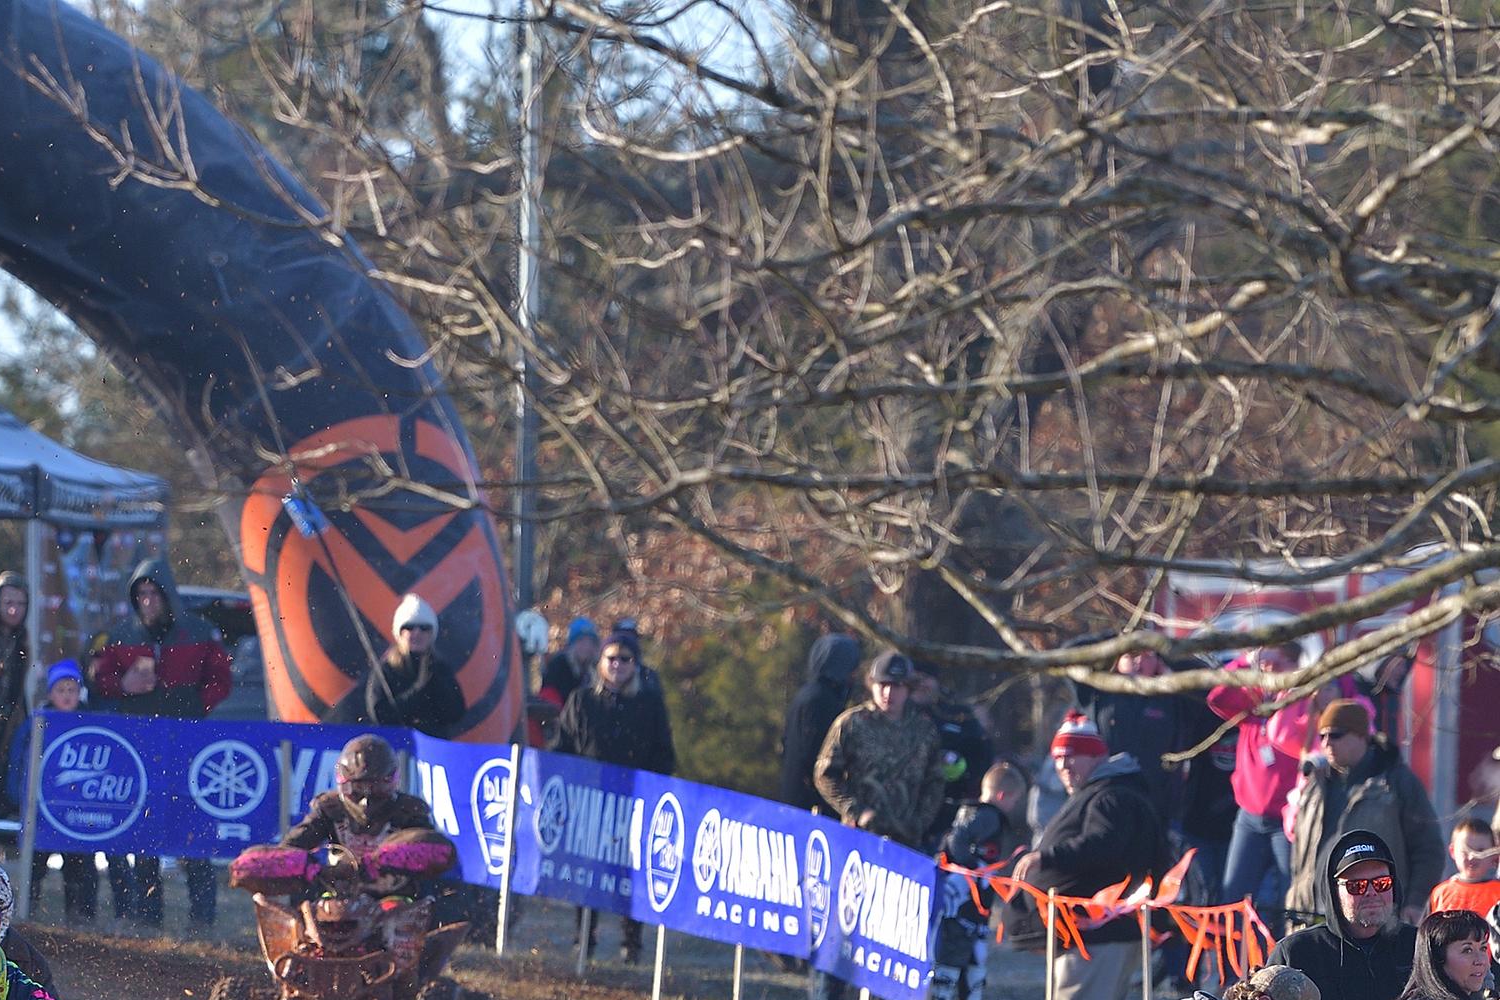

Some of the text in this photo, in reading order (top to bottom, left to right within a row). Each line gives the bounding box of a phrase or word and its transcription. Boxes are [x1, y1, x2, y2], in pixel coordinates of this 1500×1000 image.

[565, 783, 644, 871] YAMAHA
[541, 859, 632, 897] RACING
[719, 817, 802, 909] YAMAHA
[696, 895, 799, 936] RACING
[859, 861, 930, 962] YAMAHA
[843, 940, 920, 989] RACING
